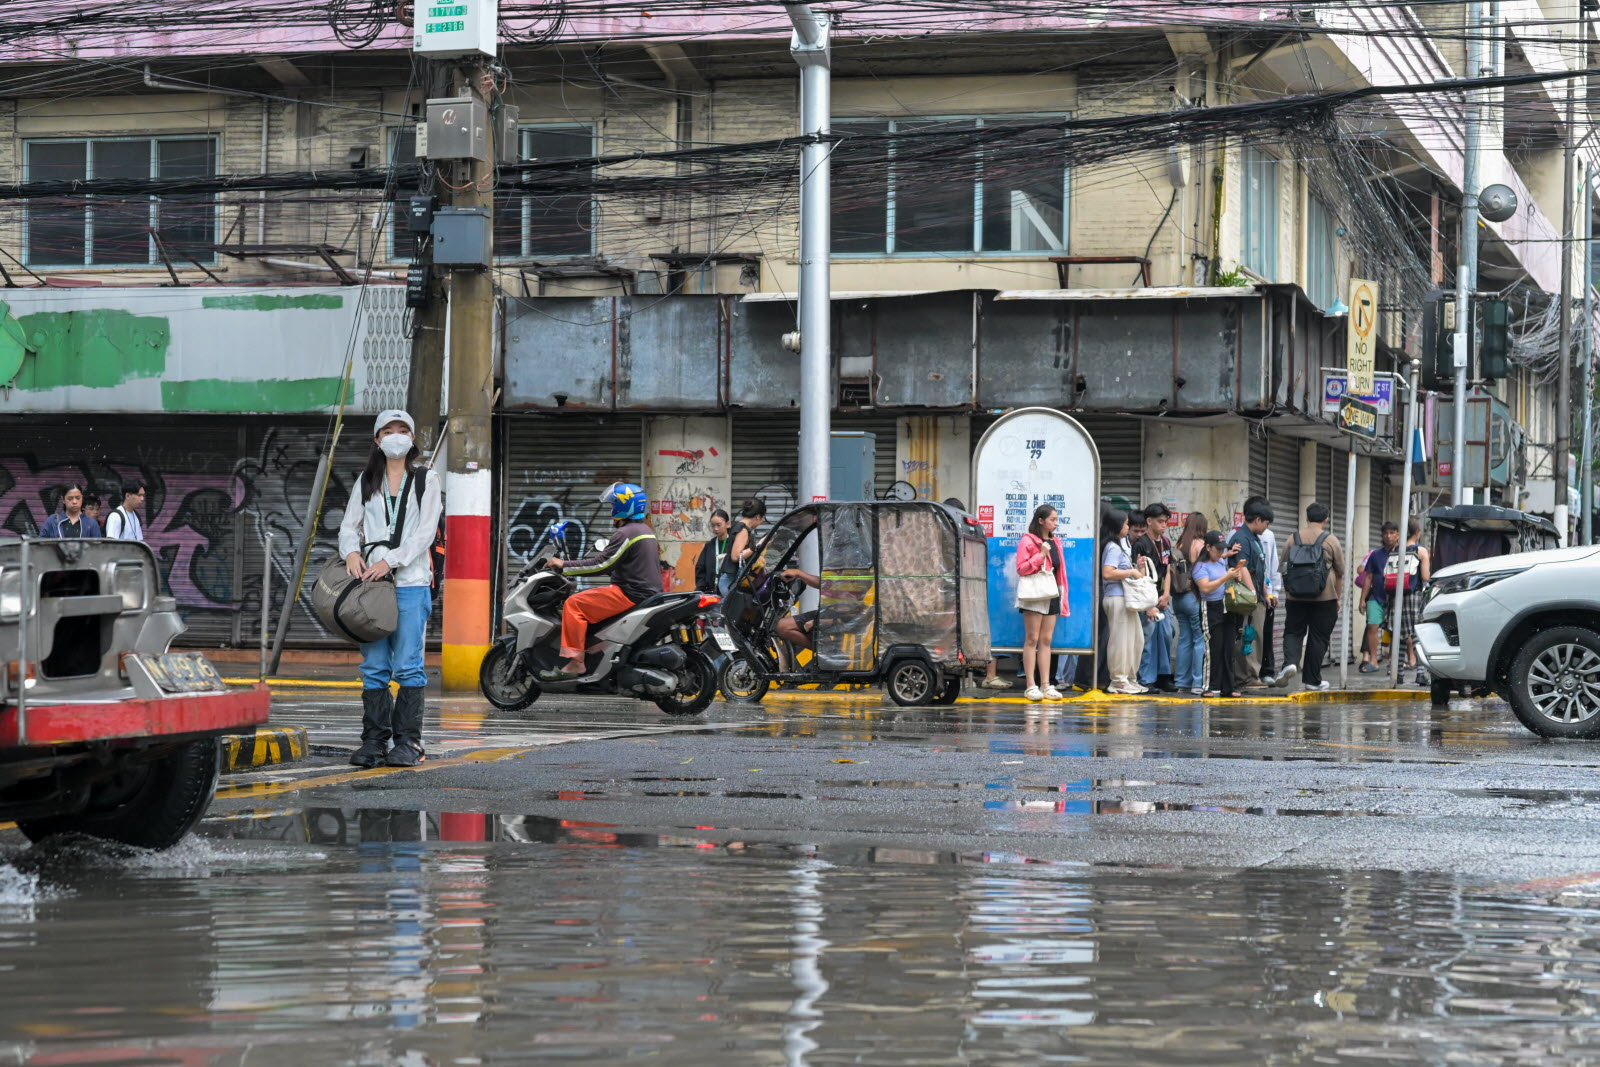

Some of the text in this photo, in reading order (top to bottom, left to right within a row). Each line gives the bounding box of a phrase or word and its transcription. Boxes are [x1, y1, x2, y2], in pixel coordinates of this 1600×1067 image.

[1355, 342, 1368, 355] NO
[1350, 359, 1372, 373] RIGHT
[1353, 376, 1370, 391] URN
[1345, 407, 1376, 428] ONE WAY
[1026, 440, 1046, 450] ZONE
[1030, 450, 1042, 459] 79
